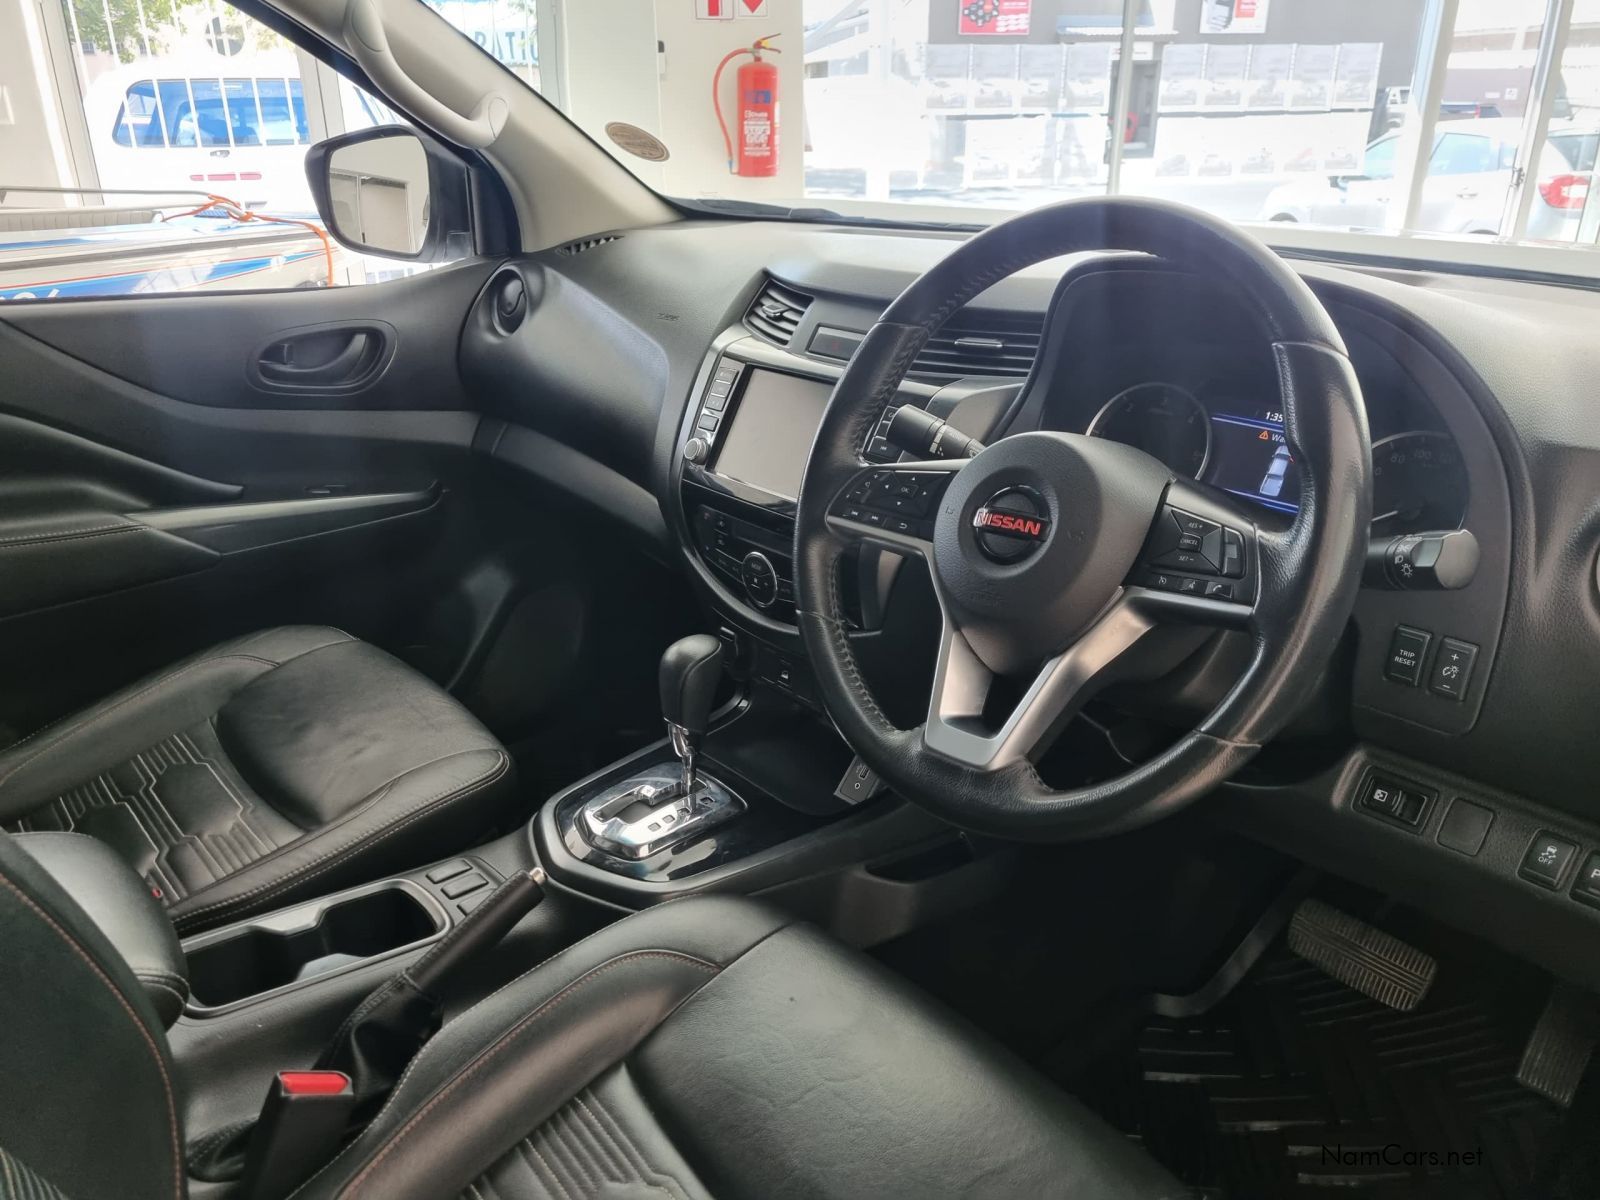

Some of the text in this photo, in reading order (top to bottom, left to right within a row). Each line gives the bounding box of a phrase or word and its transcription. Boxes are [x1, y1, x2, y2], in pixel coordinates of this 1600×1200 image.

[1265, 411, 1283, 423] 1:35
[977, 509, 1041, 536] NISSAN
[1180, 538, 1198, 546] CANCEL
[1400, 649, 1415, 658] TRIP
[1394, 655, 1416, 667] RESET
[1538, 856, 1553, 865] OFF
